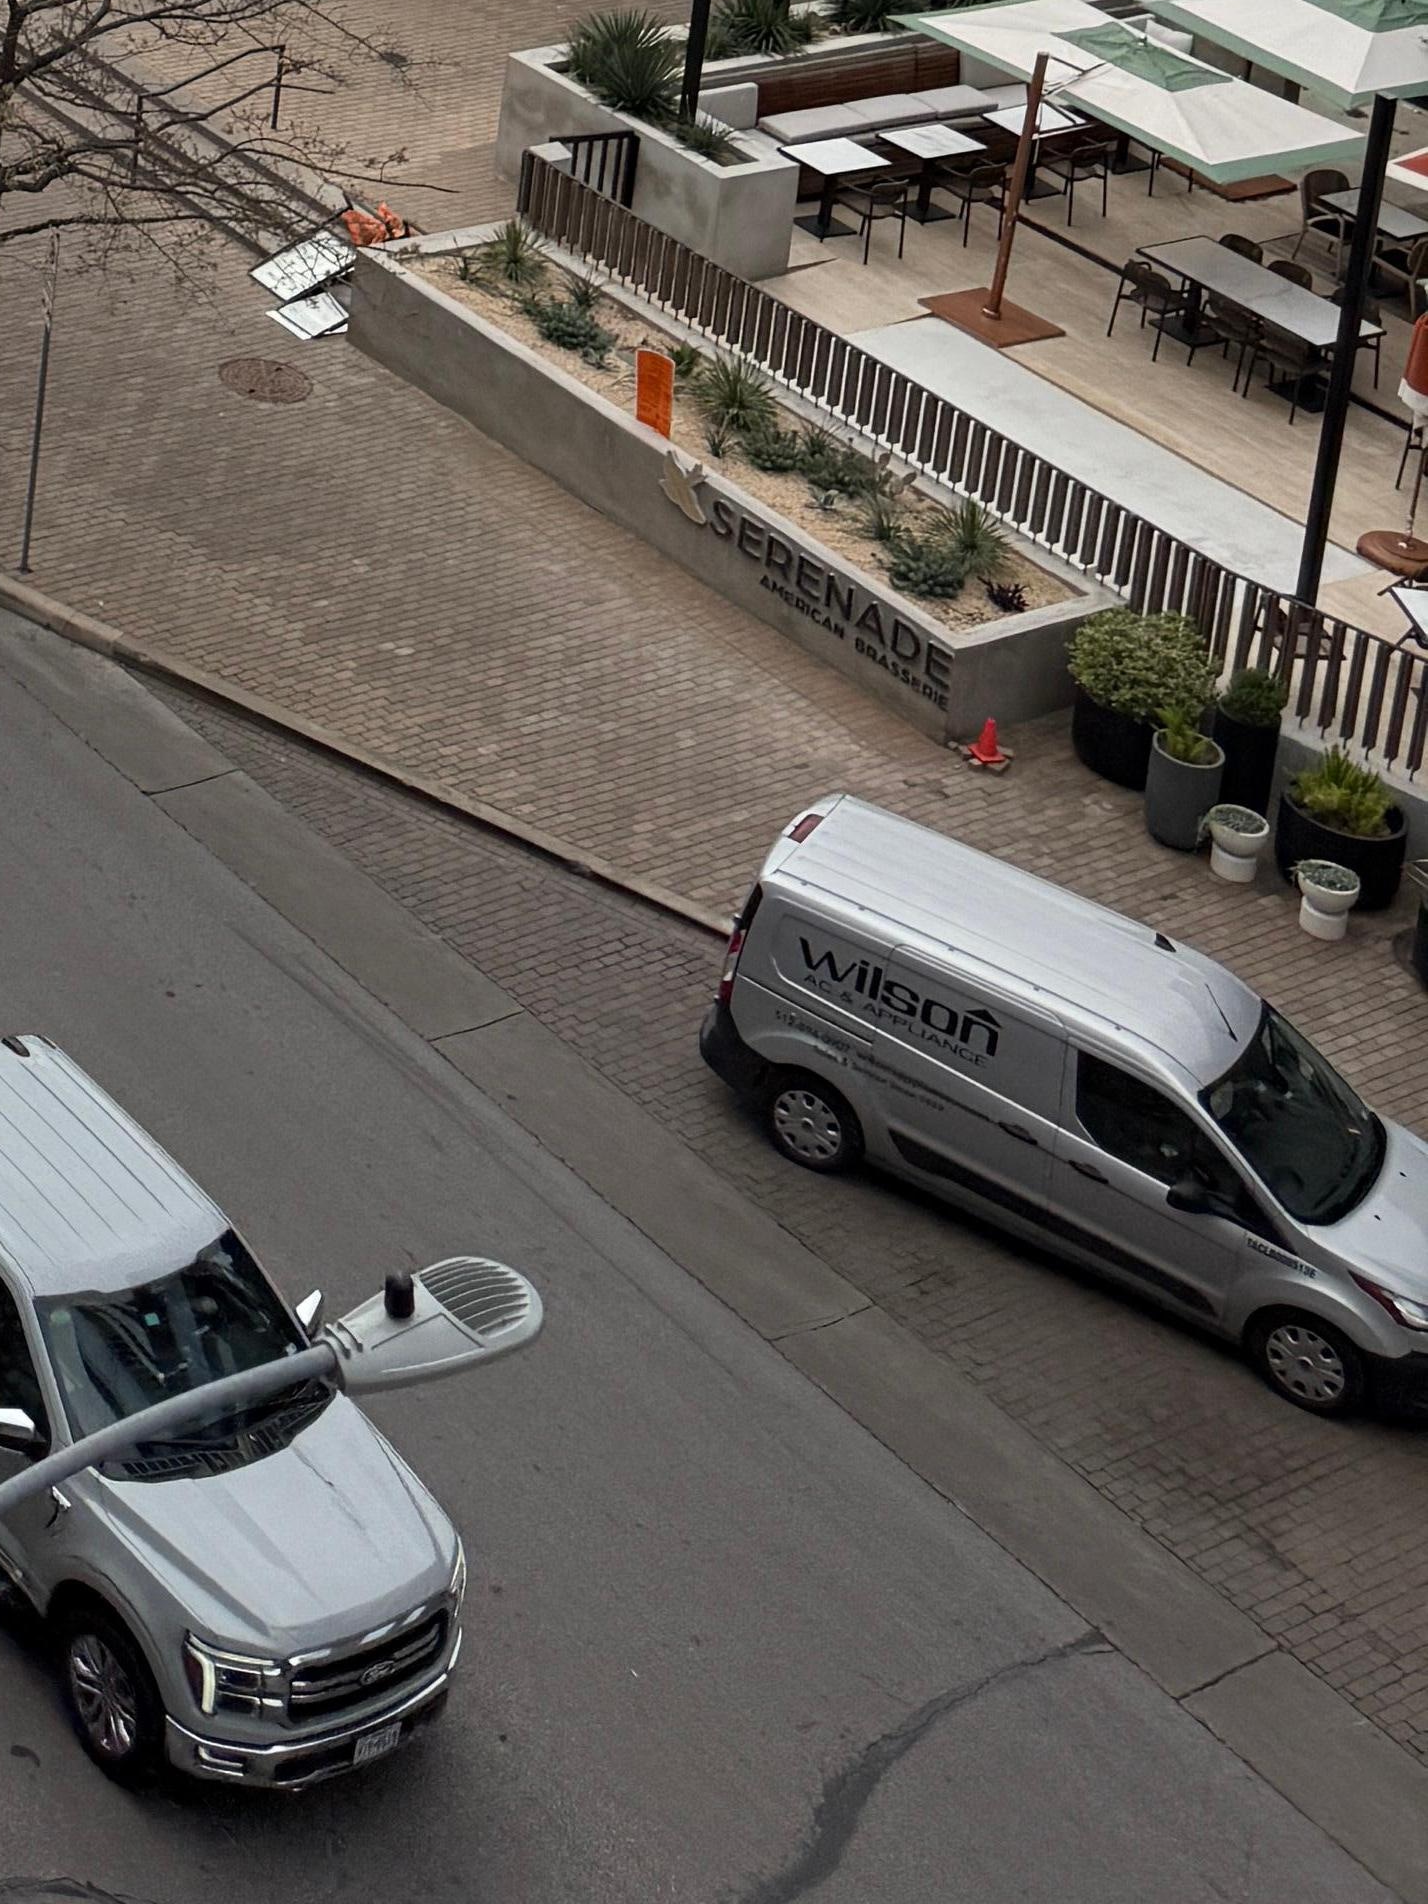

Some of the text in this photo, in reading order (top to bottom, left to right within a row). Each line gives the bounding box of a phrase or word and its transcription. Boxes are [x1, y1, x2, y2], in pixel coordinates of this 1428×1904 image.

[709, 498, 956, 692] SERENADE
[759, 574, 950, 713] AMERICAN BRASSERIE
[803, 974, 989, 1068] AC & APPLIANCE
